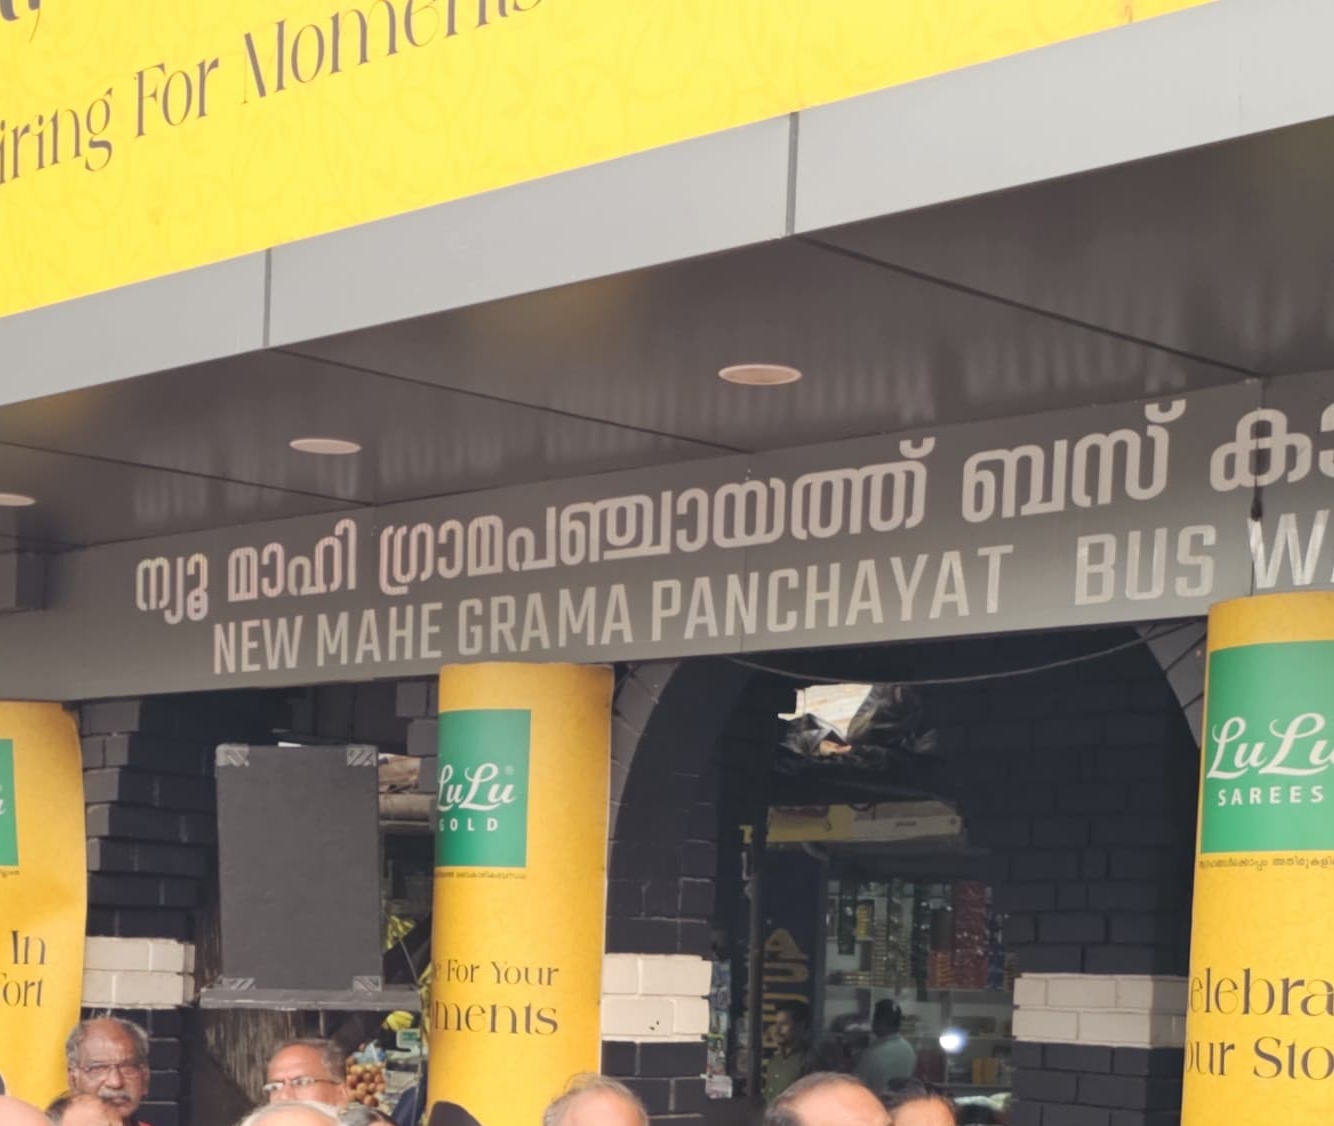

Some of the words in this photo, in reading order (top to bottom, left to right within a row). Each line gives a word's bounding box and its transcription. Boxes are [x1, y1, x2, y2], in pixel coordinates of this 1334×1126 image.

[133, 57, 220, 139] For
[227, 517, 358, 603] മാഹി
[378, 436, 936, 596] ഗ്രാമപഞ്ചായത്ത്
[962, 399, 1187, 523] ബസ്
[213, 614, 304, 675] NEW
[316, 601, 444, 668] MAHE
[456, 583, 634, 657] GRAMA
[650, 544, 1015, 642] PANCHAYAT
[1074, 524, 1217, 607] BUS
[1217, 784, 1325, 807] SAREES
[11, 929, 46, 966] In
[447, 958, 481, 984] For
[490, 960, 560, 987] Your
